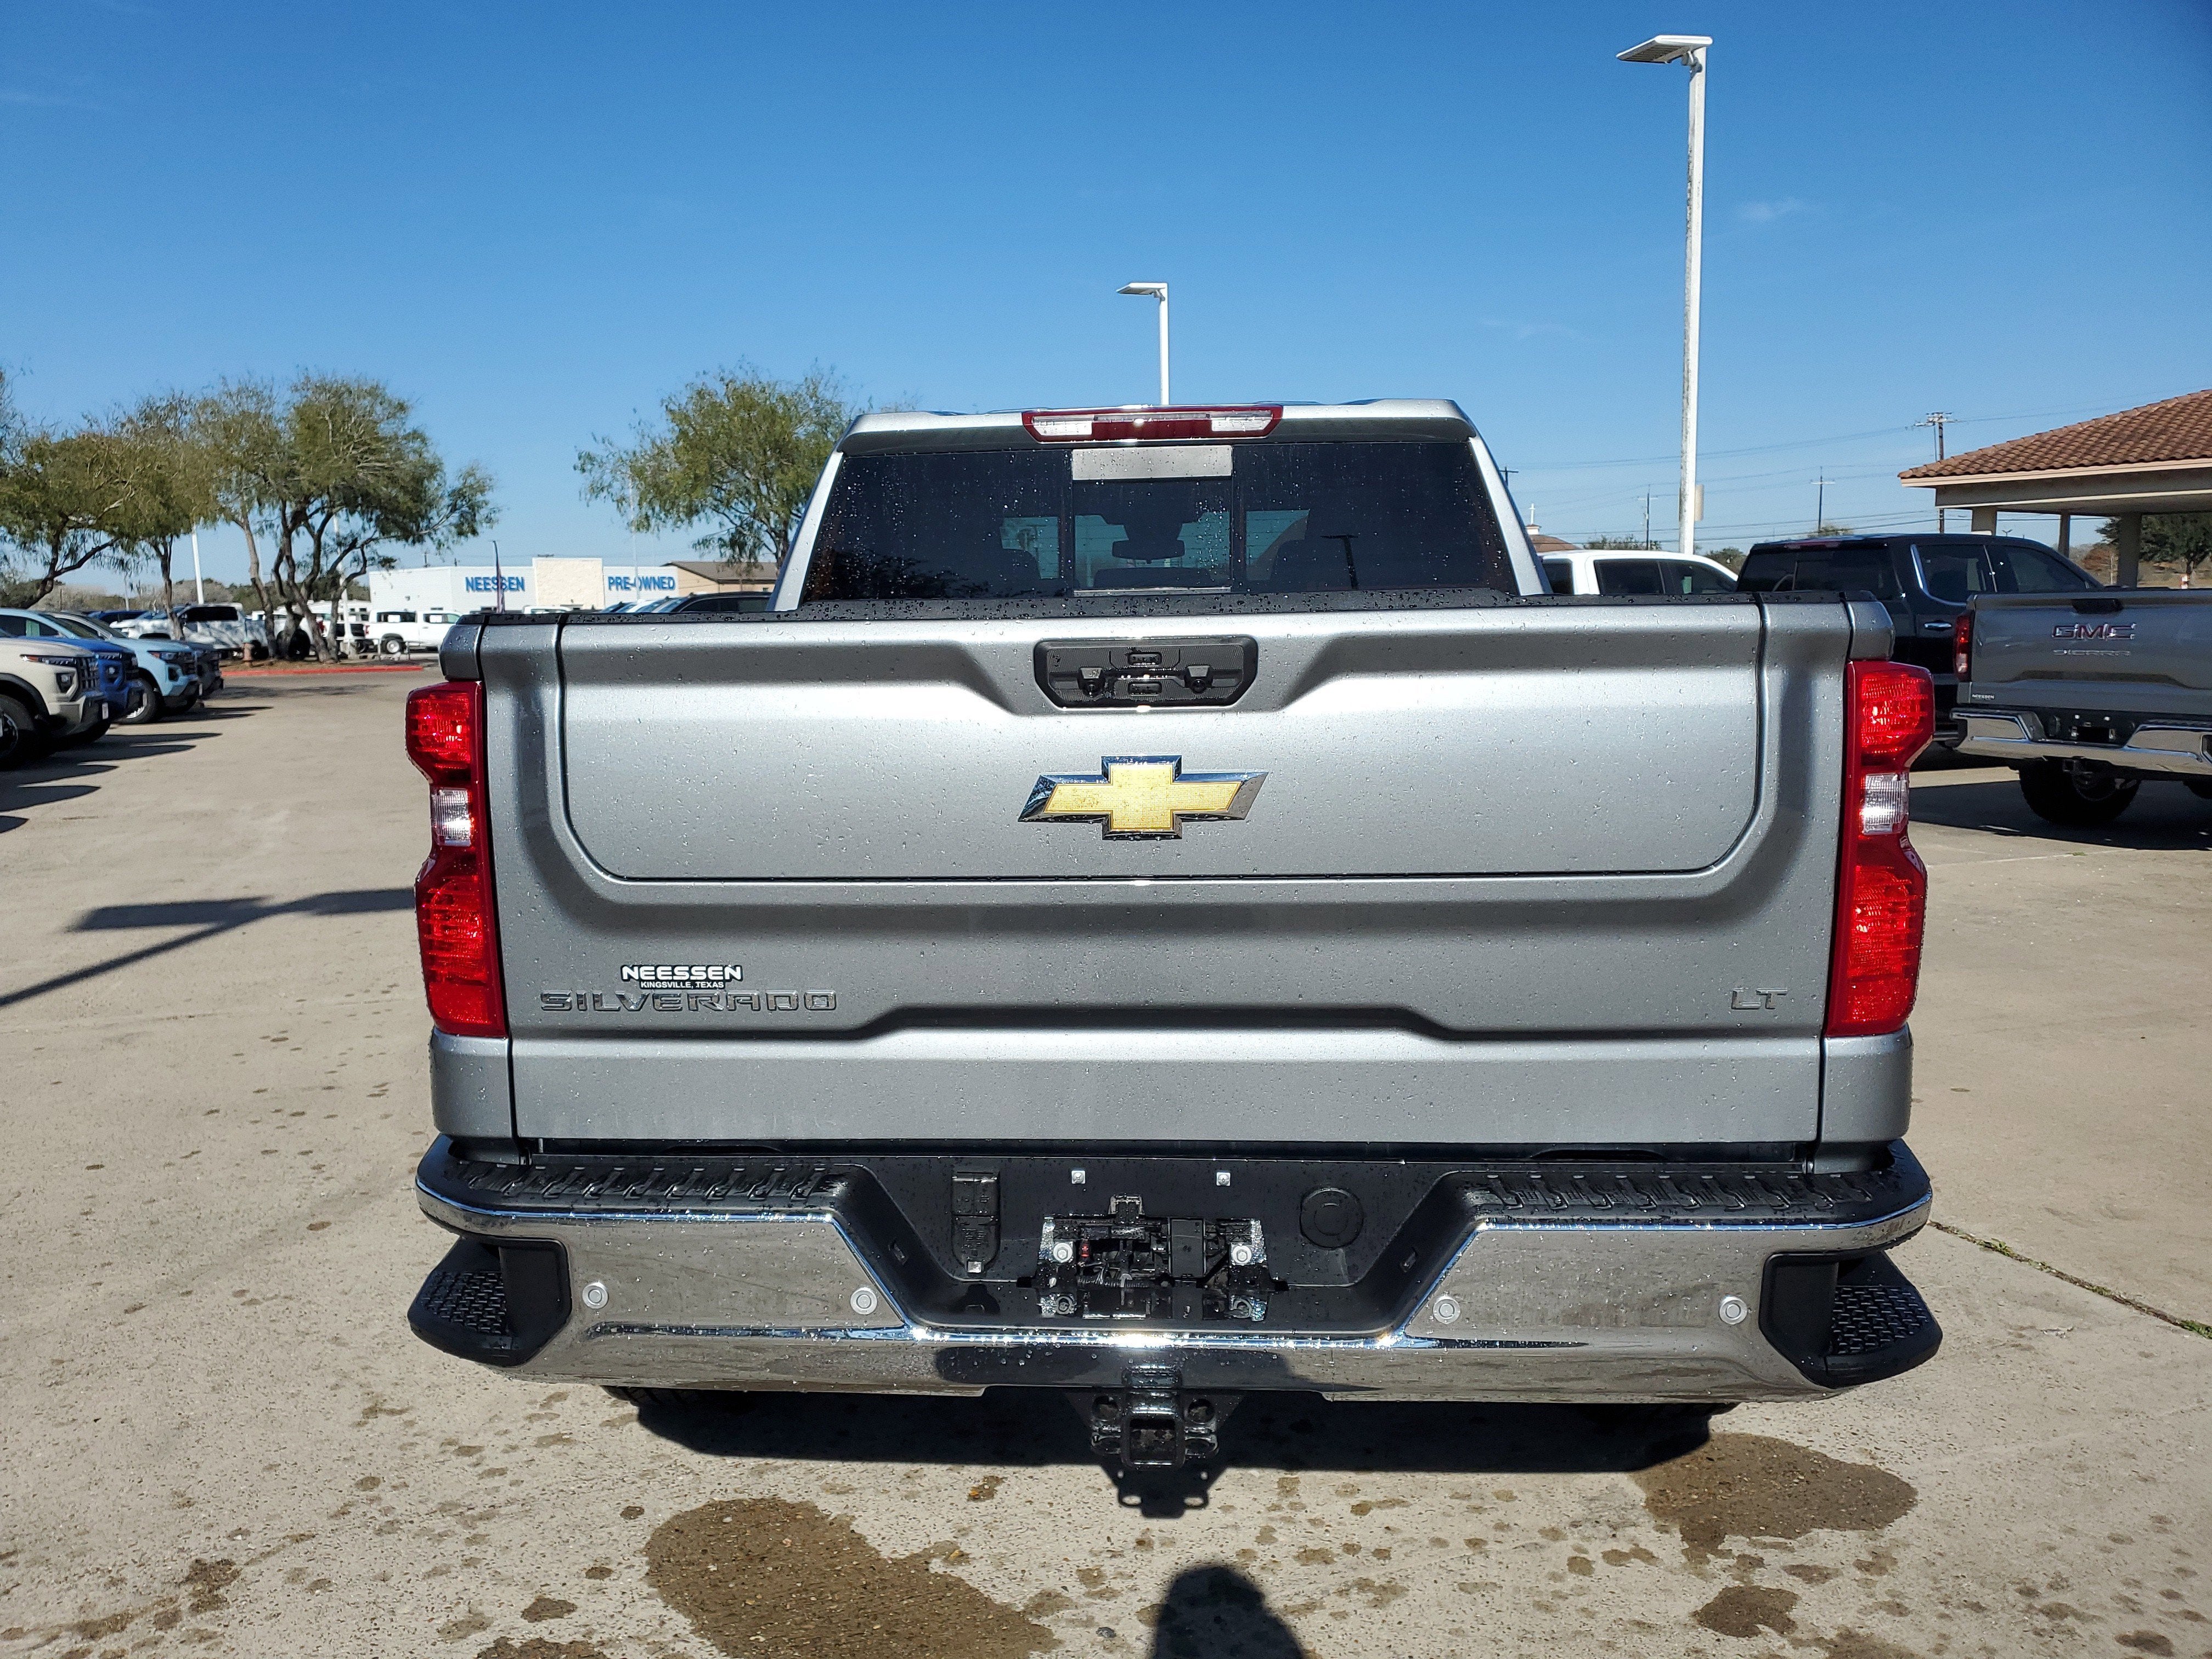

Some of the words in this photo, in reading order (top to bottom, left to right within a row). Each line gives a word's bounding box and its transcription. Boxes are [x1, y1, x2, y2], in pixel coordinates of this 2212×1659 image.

[465, 577, 524, 591] NEESSEN
[608, 576, 675, 590] PRE-OWNED
[2052, 623, 2136, 640] GMC
[622, 966, 742, 980] NEESSEN
[540, 990, 837, 1011] SILVERADO
[1731, 988, 1788, 1009] LT
